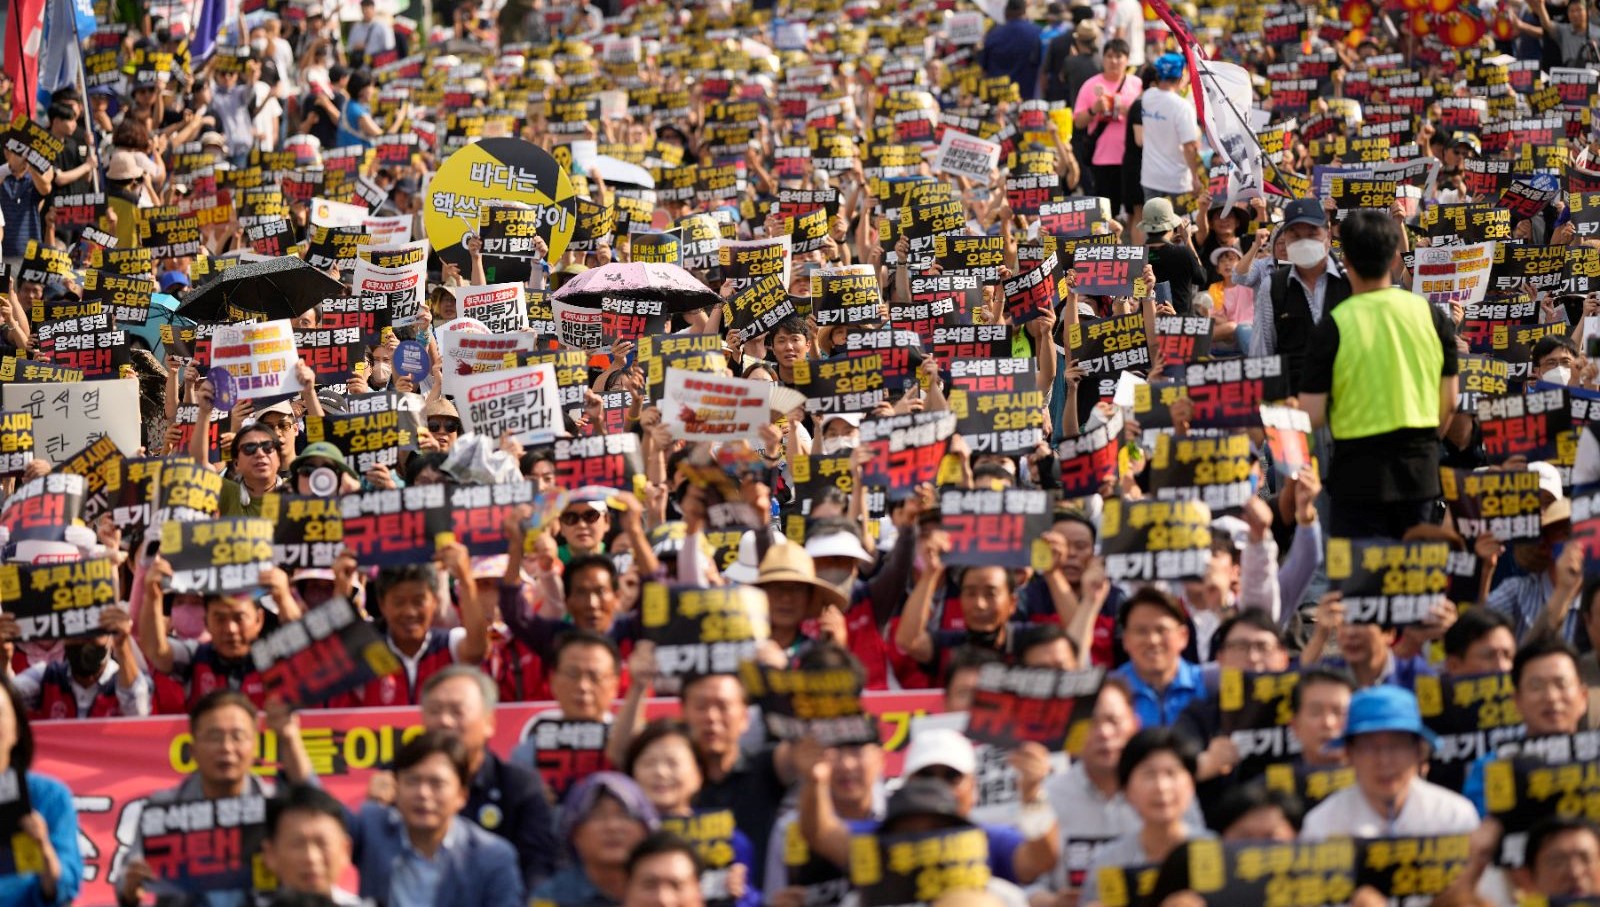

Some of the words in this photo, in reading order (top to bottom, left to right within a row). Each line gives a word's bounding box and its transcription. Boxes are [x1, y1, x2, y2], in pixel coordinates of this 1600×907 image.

[470, 162, 538, 193] 바다는
[814, 188, 836, 202] 정권
[1350, 181, 1396, 194] 후쿠시마
[1509, 184, 1544, 201] 윤석열
[1040, 201, 1073, 216] 윤석열
[1073, 198, 1097, 211] 정권
[1360, 194, 1396, 207] 오염수
[494, 210, 537, 222] 후쿠시마
[919, 201, 963, 222] 후쿠시마
[1472, 209, 1511, 226] 후쿠시마
[265, 220, 288, 236] 정권
[504, 225, 536, 236] 오염수
[932, 214, 966, 233] 오염수
[483, 239, 506, 252] 투기
[737, 244, 784, 263] 후쿠시마
[954, 237, 1004, 253] 후쿠시마
[1074, 246, 1115, 261] 윤석열
[1117, 246, 1144, 260] 정권
[1512, 244, 1565, 261] 후쿠시마
[109, 247, 152, 263] 후쿠시마
[966, 251, 1004, 265] 오염수
[748, 259, 784, 276] 오염수
[1004, 267, 1043, 297] 윤석열
[1040, 251, 1059, 276] 정권
[1075, 261, 1129, 286] 규탄!
[1524, 261, 1564, 274] 오염수
[103, 277, 153, 294] 후쿠시마
[829, 277, 878, 292] 후쿠시마
[911, 277, 951, 294] 윤석열
[952, 275, 978, 289] 정권
[1496, 275, 1527, 288] 투기
[114, 290, 150, 305] 오염수
[735, 273, 782, 311] 후쿠시마
[841, 290, 880, 306] 오염수
[50, 299, 102, 318] 후쿠시마
[322, 297, 360, 312] 윤석열
[361, 294, 388, 311] 정권
[464, 299, 519, 321] 해양투기
[602, 298, 634, 313] 윤석열
[636, 300, 662, 315] 정권
[750, 287, 787, 318] 오염수
[890, 305, 929, 320] 윤석열
[931, 298, 954, 316] 정권
[1465, 303, 1507, 320] 윤석열
[1509, 301, 1536, 318] 정권
[116, 305, 147, 321] 철회!
[763, 299, 795, 328] 철회!
[817, 306, 845, 325] 투기
[39, 318, 78, 340] 윤석열
[80, 313, 107, 330] 정권
[333, 326, 360, 343] 정권
[561, 319, 602, 337] 해양투
[602, 312, 646, 339] 규탄!
[932, 327, 976, 343] 윤석열
[977, 325, 1007, 341] 정권
[1087, 313, 1143, 340] 후쿠시마
[1183, 316, 1211, 335] 정권
[54, 333, 95, 350] 윤석열
[97, 330, 125, 346] 정권
[661, 335, 721, 354] 후쿠시마
[846, 331, 893, 350] 윤석열
[1103, 330, 1146, 353] 오염수
[819, 355, 882, 379] 후쿠시마
[950, 359, 996, 377] 윤석열
[998, 357, 1029, 374] 정권
[1111, 347, 1148, 370] 철회!
[23, 364, 84, 383] 후쿠시마
[1186, 361, 1242, 386] 윤석열
[1243, 355, 1281, 379] 정권
[835, 371, 883, 393] 오염수
[1465, 374, 1507, 395] 오염수
[470, 387, 545, 424] 해양투기
[805, 396, 840, 413] 투기
[976, 390, 1043, 412] 후쿠시마
[1188, 379, 1265, 419] 규탄!
[1477, 395, 1525, 420] 윤석열
[1525, 387, 1564, 415] 정권
[333, 411, 398, 437] 후쿠시마
[993, 410, 1043, 430] 오염수
[350, 429, 398, 452] 오염수
[1464, 472, 1540, 497] 후쿠시마
[1480, 492, 1540, 517] 오염수
[342, 511, 426, 555] 규탄!
[941, 514, 1025, 552] 규탄!
